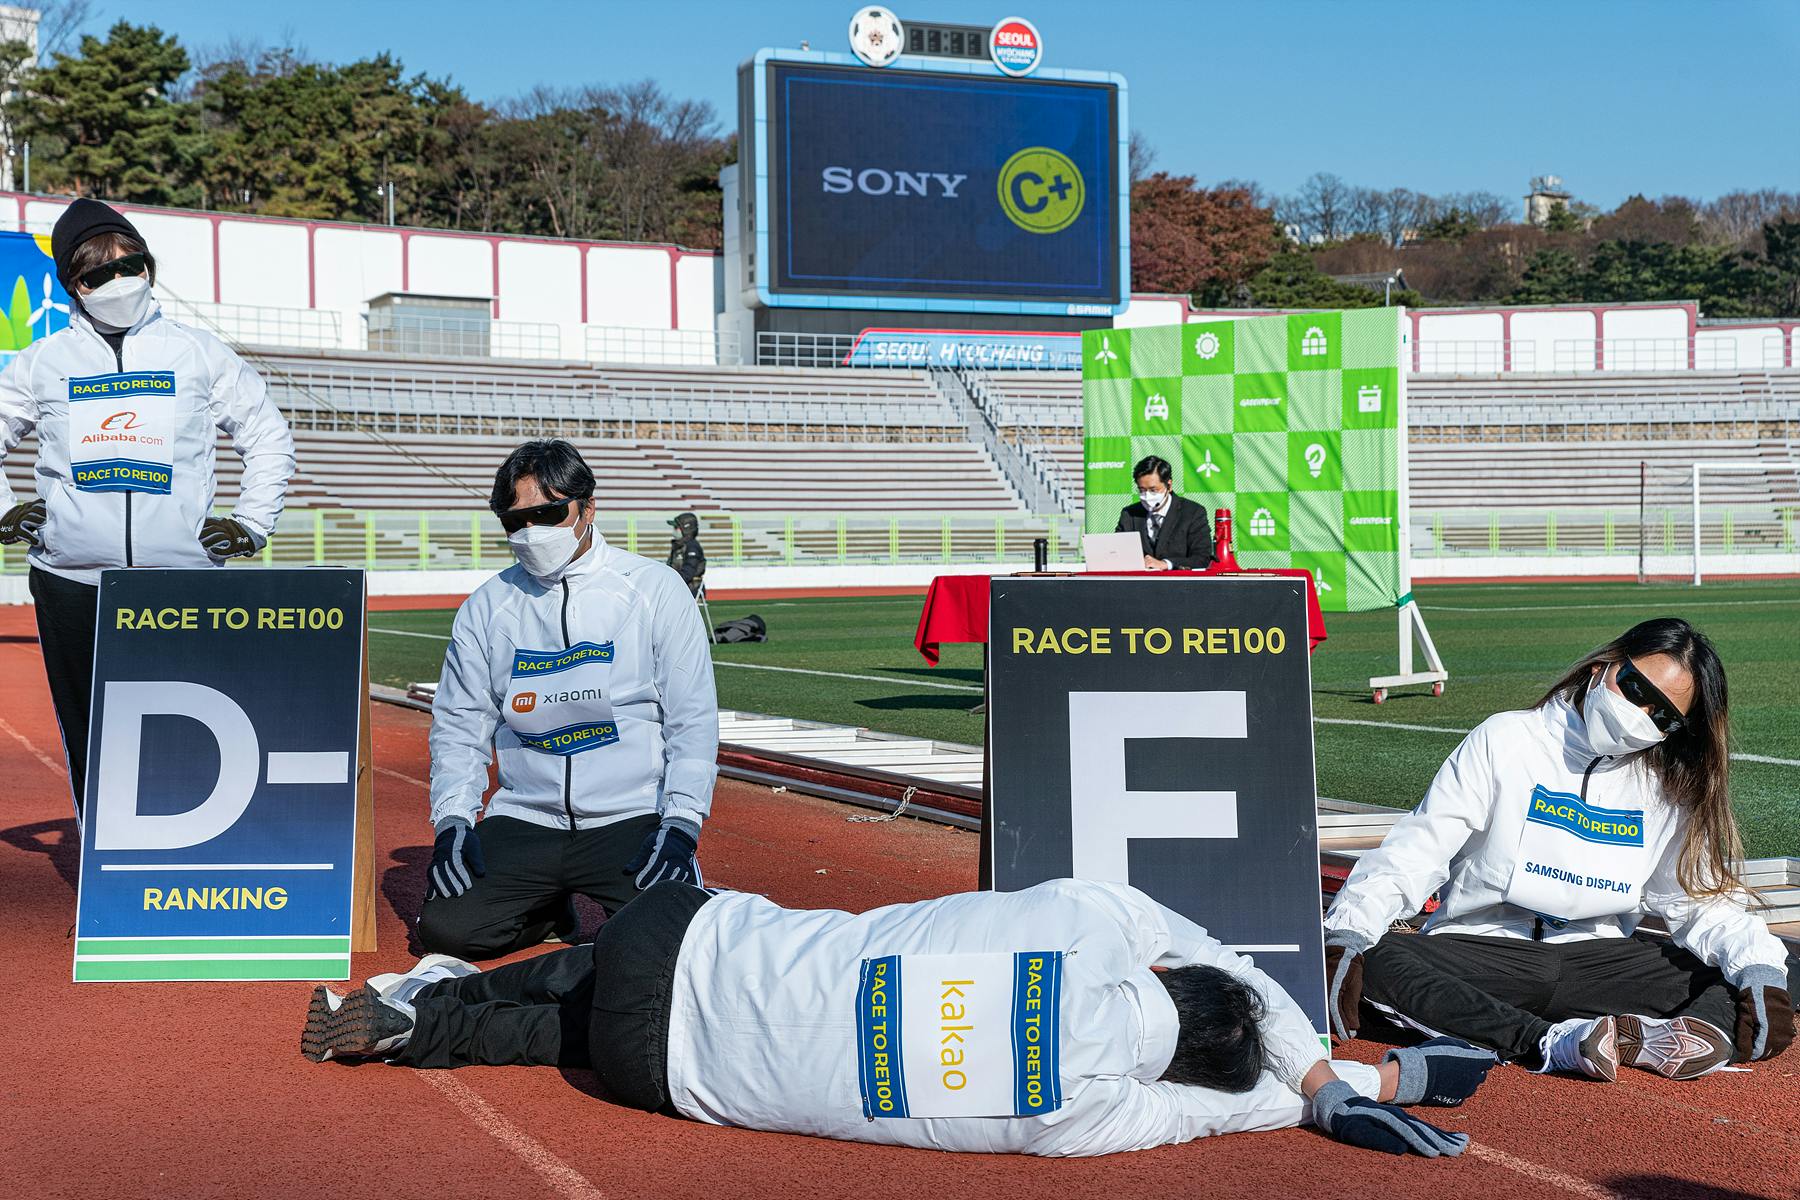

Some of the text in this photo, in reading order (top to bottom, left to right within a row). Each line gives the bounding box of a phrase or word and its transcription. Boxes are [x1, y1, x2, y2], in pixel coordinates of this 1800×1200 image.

[998, 31, 1034, 47] SEOUL
[822, 166, 967, 198] SONY
[1010, 171, 1072, 214] C+
[73, 379, 171, 394] RACE TO RE100
[77, 467, 168, 483] RACE TO RE100
[116, 607, 344, 630] RACE TO RE100
[1012, 627, 1286, 654] RACE TO RE100
[517, 649, 610, 671] RACE TO RE100
[543, 688, 602, 704] xiaomi
[553, 734, 572, 747] TO
[573, 726, 613, 742] RE100
[95, 681, 349, 850] D-
[1068, 690, 1248, 886] F
[1534, 799, 1639, 837] RACE TO RE100
[1525, 862, 1632, 894] SAMSUNG DISPLAY
[143, 887, 289, 911] RANKING
[872, 963, 893, 1111] RACE TO RE100
[940, 980, 975, 1090] kakao
[1025, 958, 1043, 1107] RACE TO RE100
